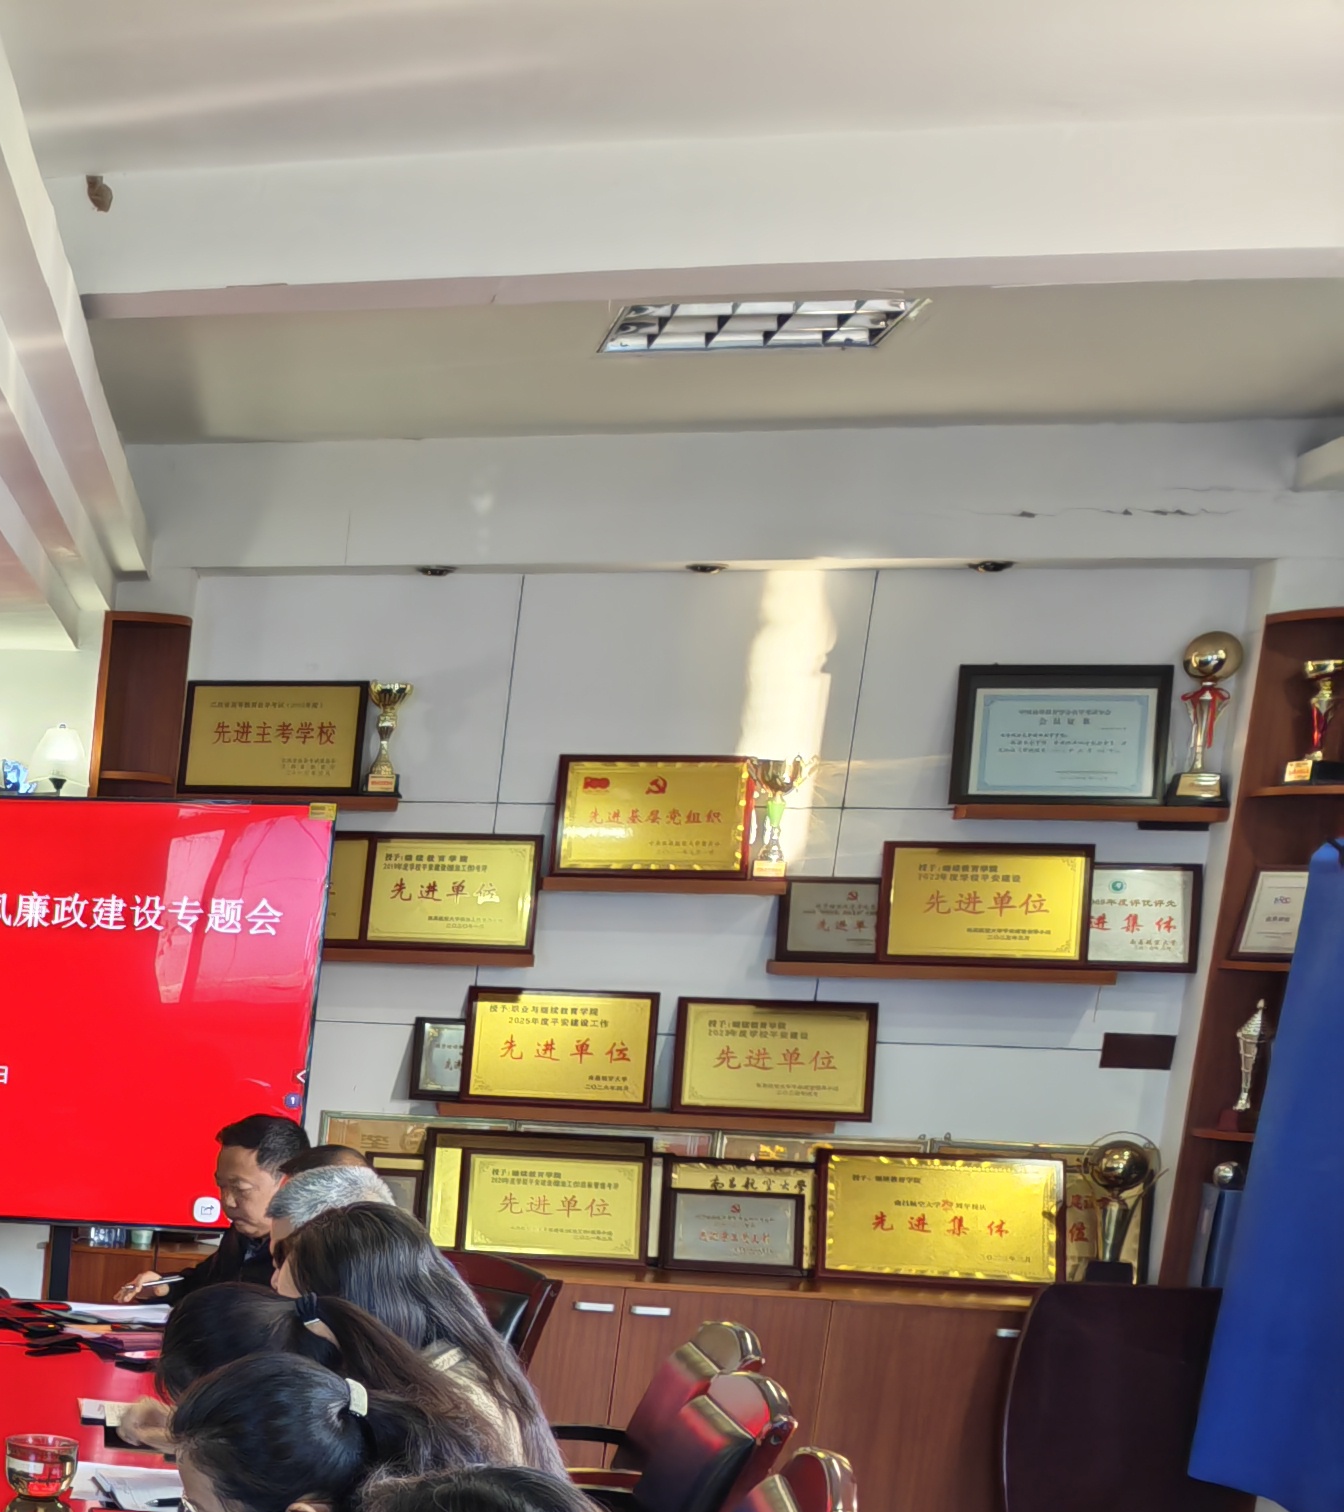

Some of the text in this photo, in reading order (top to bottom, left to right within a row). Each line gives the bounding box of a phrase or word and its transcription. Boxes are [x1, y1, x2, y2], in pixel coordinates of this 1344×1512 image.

[212, 721, 337, 745] 先进主考学校
[589, 807, 722, 825] 先进基层党组织
[390, 877, 500, 904] 先进单位
[923, 890, 1050, 917] 先进单位
[1090, 913, 1176, 933] 进集体
[508, 1017, 610, 1028] 2025年度平安建设工作
[500, 1034, 632, 1064] 先进单位
[713, 1045, 838, 1073] 先进单位
[498, 1192, 612, 1218] 先进单位
[872, 1211, 1009, 1237] 先进集体
